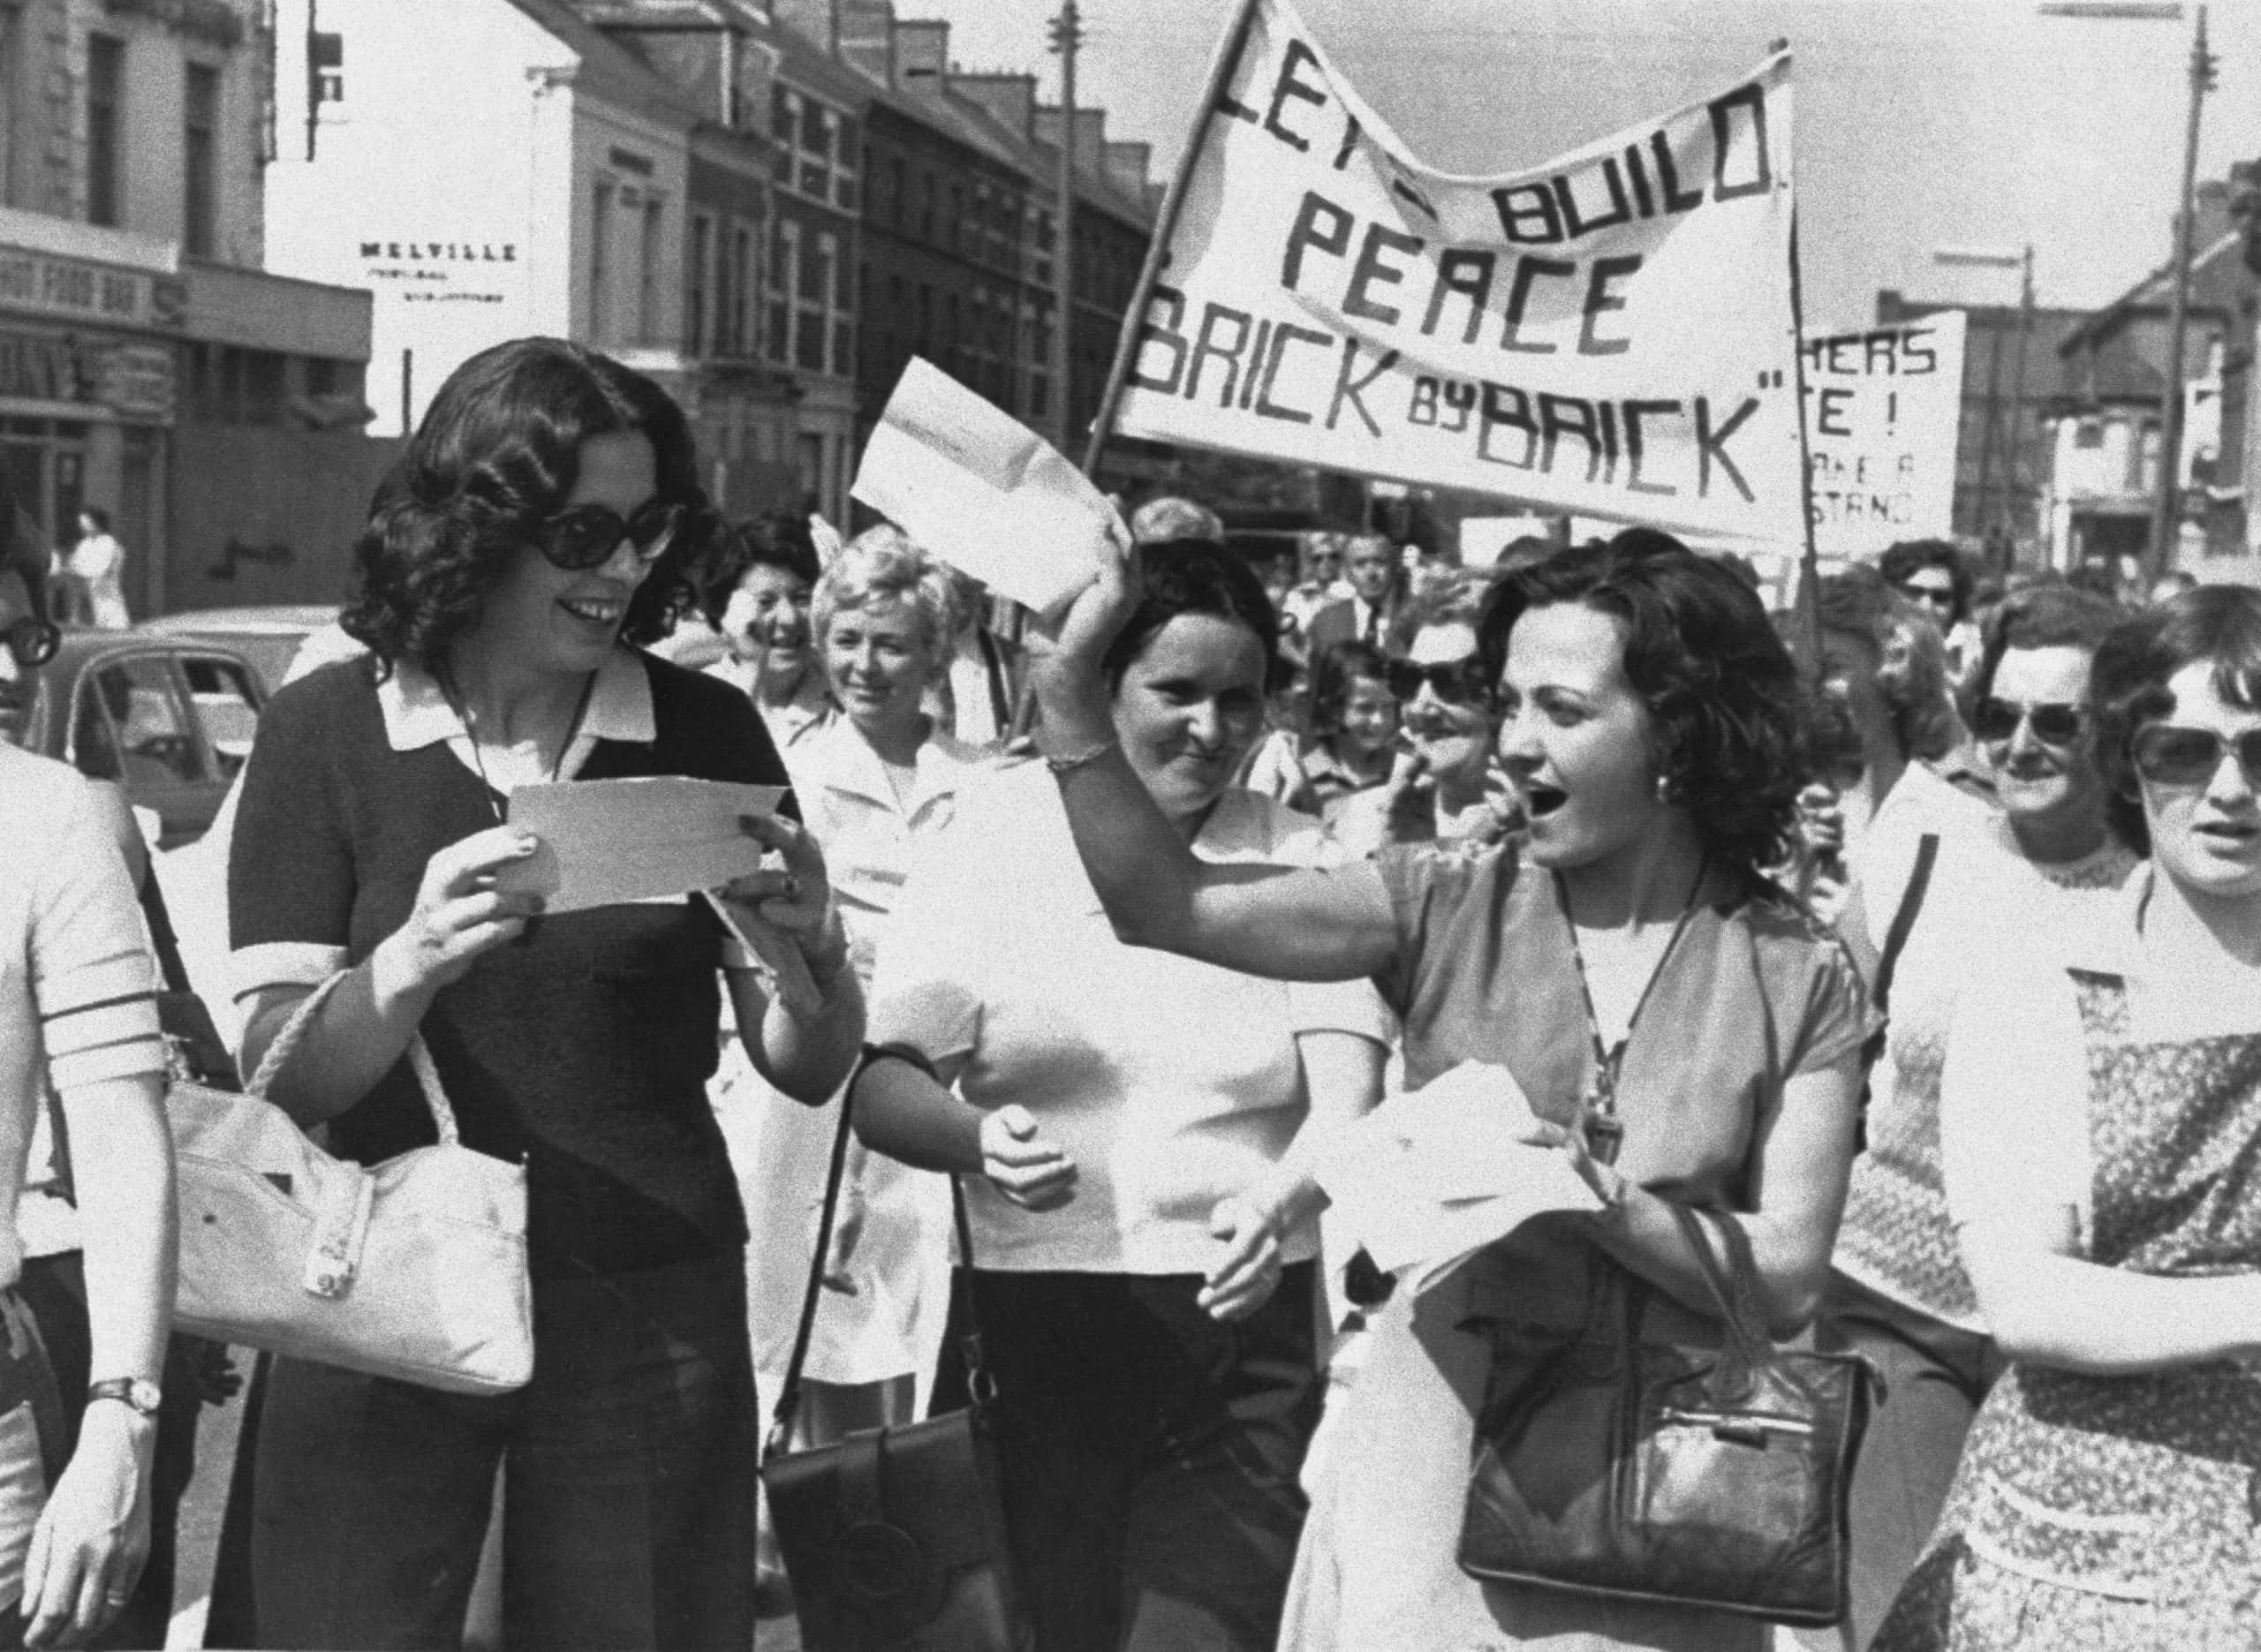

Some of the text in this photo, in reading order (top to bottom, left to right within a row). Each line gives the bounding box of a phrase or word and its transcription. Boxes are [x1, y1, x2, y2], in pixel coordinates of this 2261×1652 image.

[1489, 81, 1772, 244] BUILD
[359, 242, 517, 262] MELVILLE
[1281, 190, 1644, 356] PEACE
[1125, 282, 1402, 438] BRICK
[1407, 375, 1478, 433] BY
